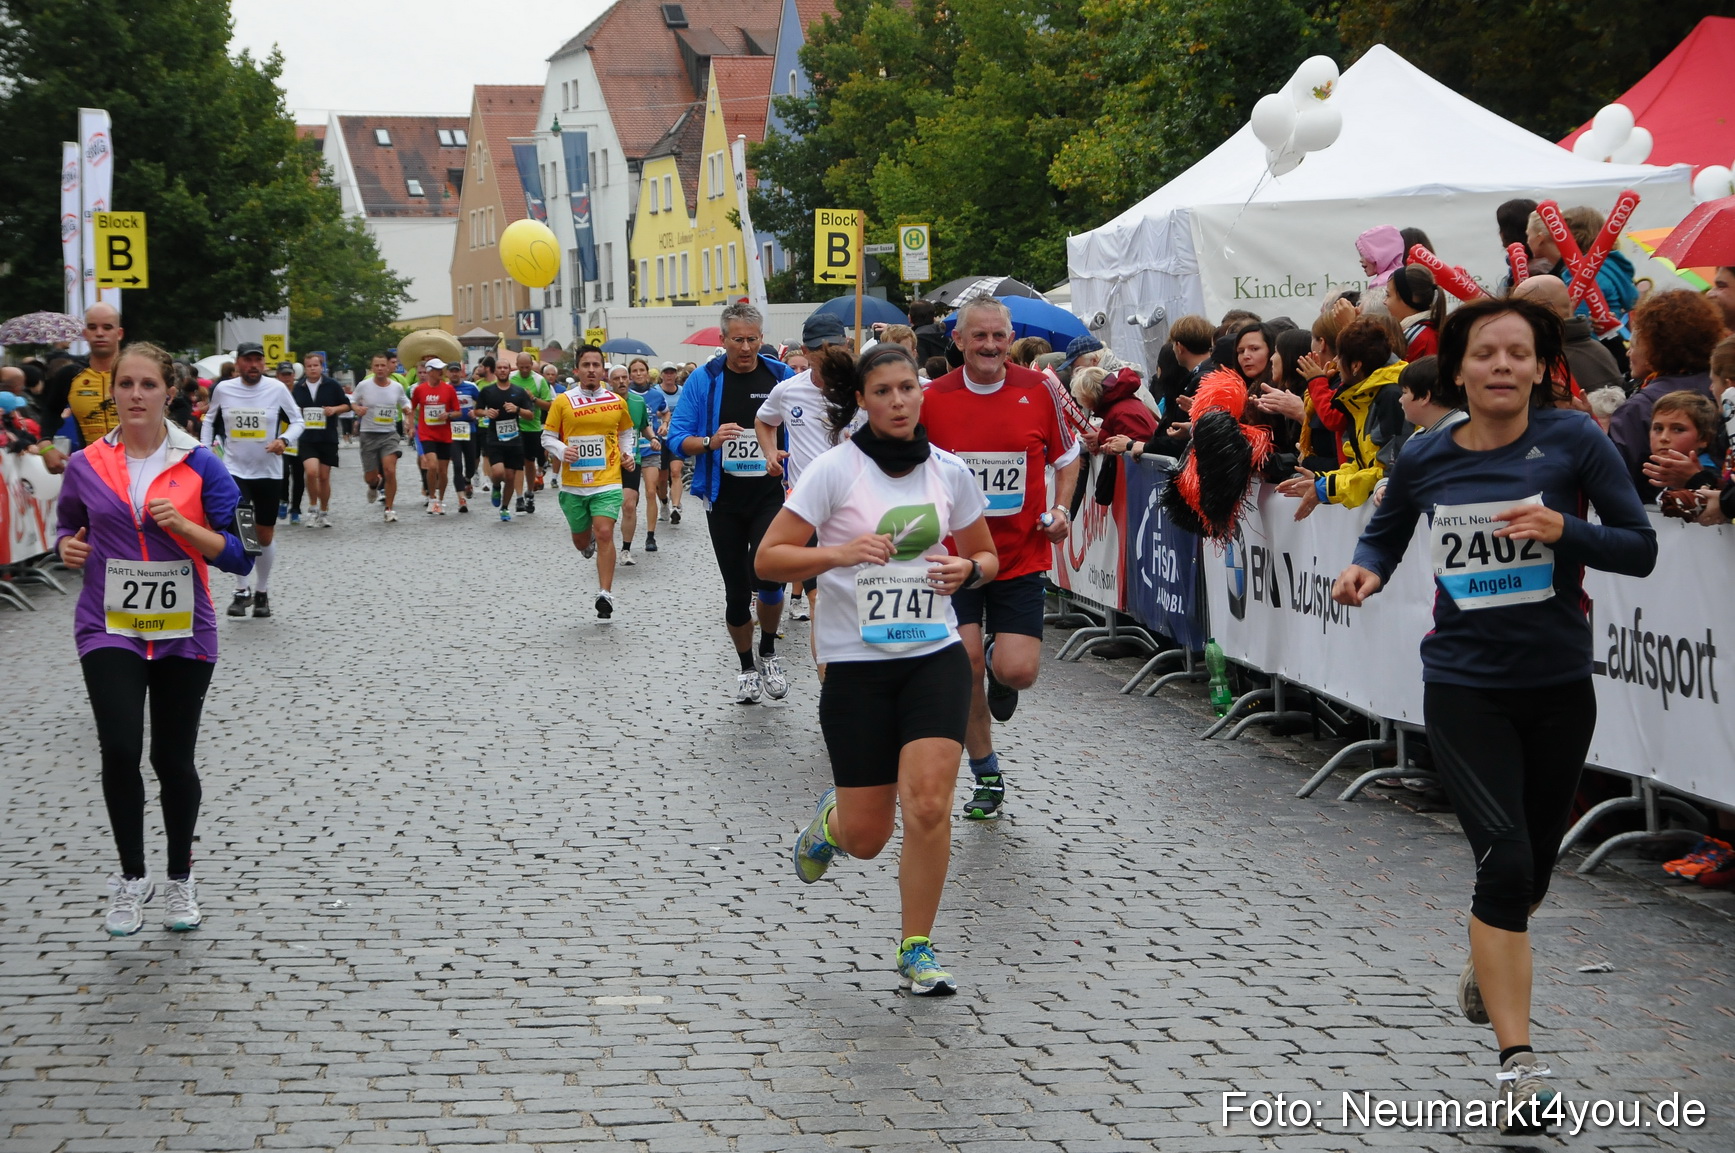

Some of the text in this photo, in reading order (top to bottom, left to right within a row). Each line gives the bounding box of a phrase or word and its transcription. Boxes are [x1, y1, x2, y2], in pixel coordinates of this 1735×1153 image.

[98, 215, 140, 229] Block
[821, 213, 858, 226] Block
[108, 235, 133, 271] B
[827, 232, 851, 267] B
[1581, 245, 1608, 279] BKK
[1233, 274, 1317, 299] Kinder
[1586, 288, 1611, 323] Audi
[519, 313, 539, 331] KL
[268, 344, 279, 360] C
[378, 409, 392, 417] 442
[573, 404, 623, 418] MAX BÖGL
[235, 416, 259, 428] 348
[574, 444, 602, 457] 095
[969, 468, 1020, 491] 142
[1433, 517, 1467, 526] PARTL
[1441, 528, 1543, 569] 2402
[108, 567, 178, 577] PARTL Neumarkt
[857, 577, 887, 586] PARTL
[1468, 574, 1523, 595] Angela
[122, 580, 177, 609] 276
[866, 588, 934, 620] 2747
[132, 618, 165, 630] Jenny
[886, 627, 927, 640] Kerstin
